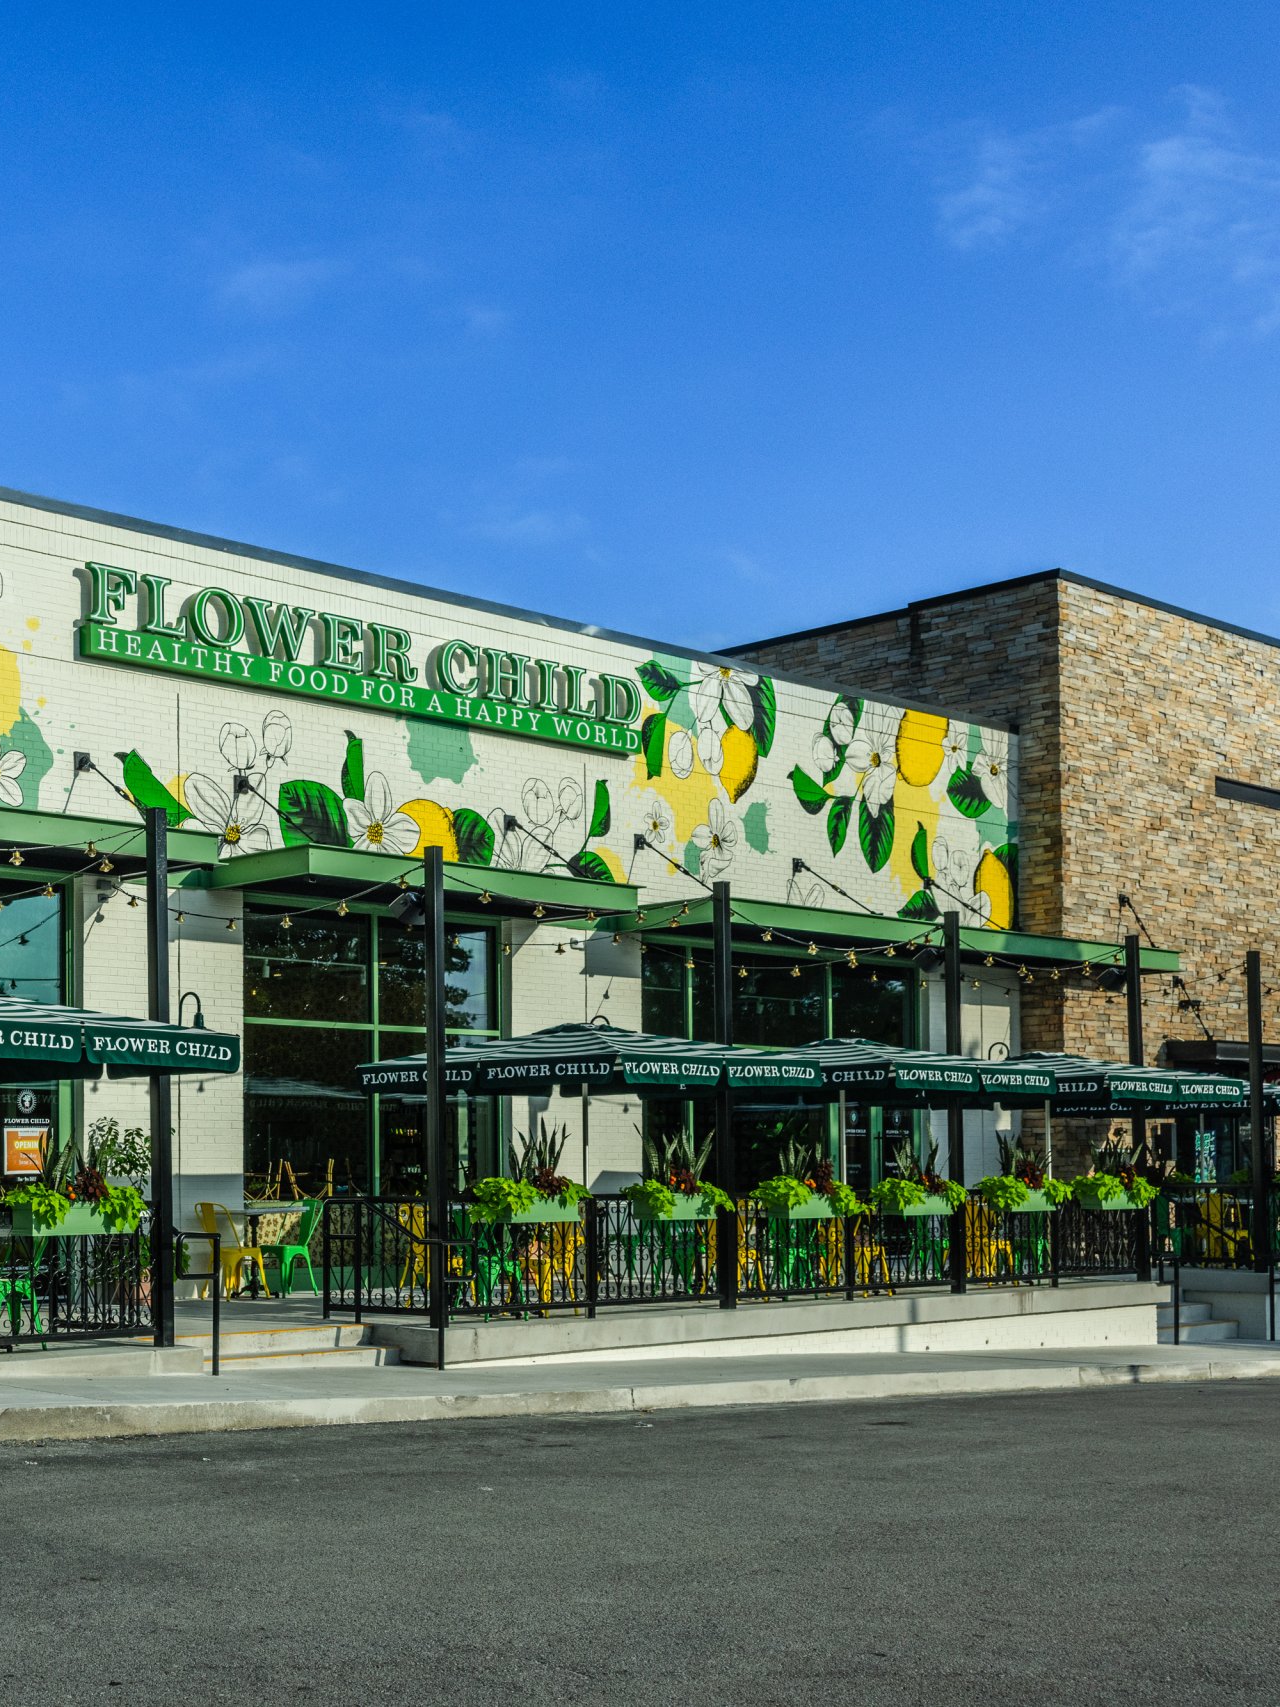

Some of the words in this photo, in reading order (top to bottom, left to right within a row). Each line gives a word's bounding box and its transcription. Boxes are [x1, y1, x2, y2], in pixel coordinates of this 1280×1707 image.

[84, 560, 419, 684] FLOWER
[436, 638, 642, 727] CHILD
[96, 628, 255, 678] HEALTHY
[268, 662, 349, 696] FOOD
[361, 680, 416, 709] FOR
[426, 693, 445, 714] A
[455, 697, 543, 732] HAPPY
[552, 716, 640, 750] WORLD
[10, 1030, 75, 1050] CHILD
[93, 1035, 171, 1054] FLOWER
[175, 1040, 233, 1061] CHILD
[362, 1071, 420, 1085] FLOWER
[422, 1069, 472, 1081] CILD
[487, 1064, 551, 1079] FLOWER
[554, 1062, 611, 1076] CHILD
[624, 1061, 680, 1075] FLOWER
[681, 1063, 720, 1077] CHILD
[728, 1065, 780, 1078] FLOWER
[781, 1066, 815, 1079] CHILD
[831, 1070, 886, 1083] CHILD
[898, 1069, 942, 1081] FLOWER
[943, 1072, 973, 1084] CHILD
[1058, 1082, 1098, 1093] HILD
[1110, 1080, 1148, 1092] FLOWER
[1148, 1082, 1173, 1094] CHILD
[14, 1140, 39, 1149] OPENIN
